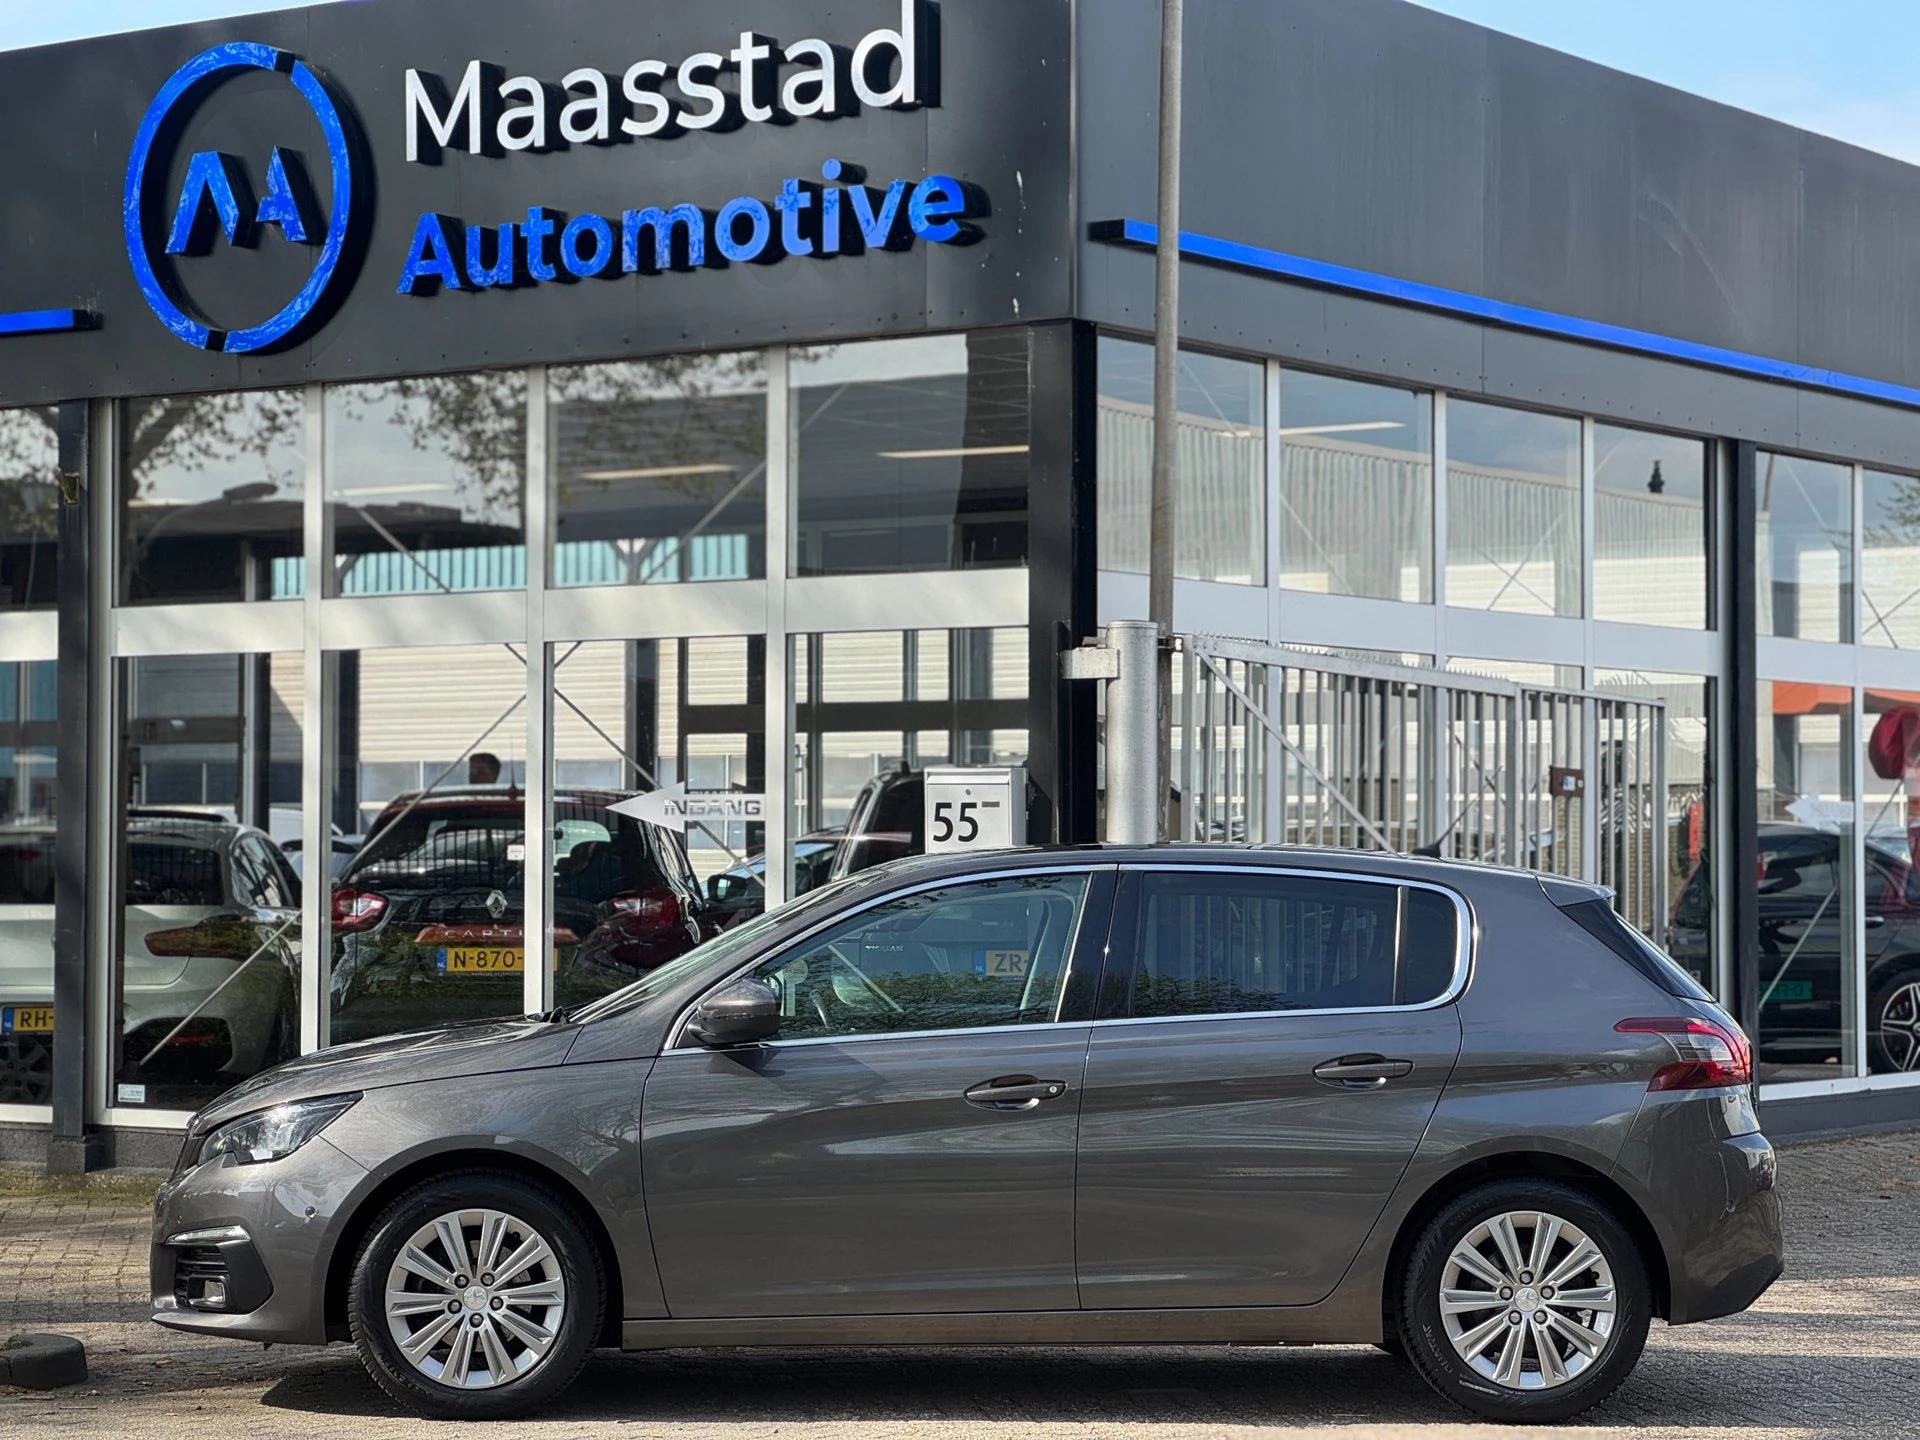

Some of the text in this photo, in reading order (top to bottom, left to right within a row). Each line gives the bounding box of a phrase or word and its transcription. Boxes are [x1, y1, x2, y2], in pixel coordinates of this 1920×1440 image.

[405, 0, 916, 162] Maasstad
[396, 159, 966, 295] Automotive
[664, 800, 761, 816] INGANG
[932, 802, 979, 843] 55
[444, 929, 523, 938] CAPT
[453, 951, 523, 968] N-870-
[994, 953, 1028, 973] ZR-
[20, 1010, 54, 1028] RH-
